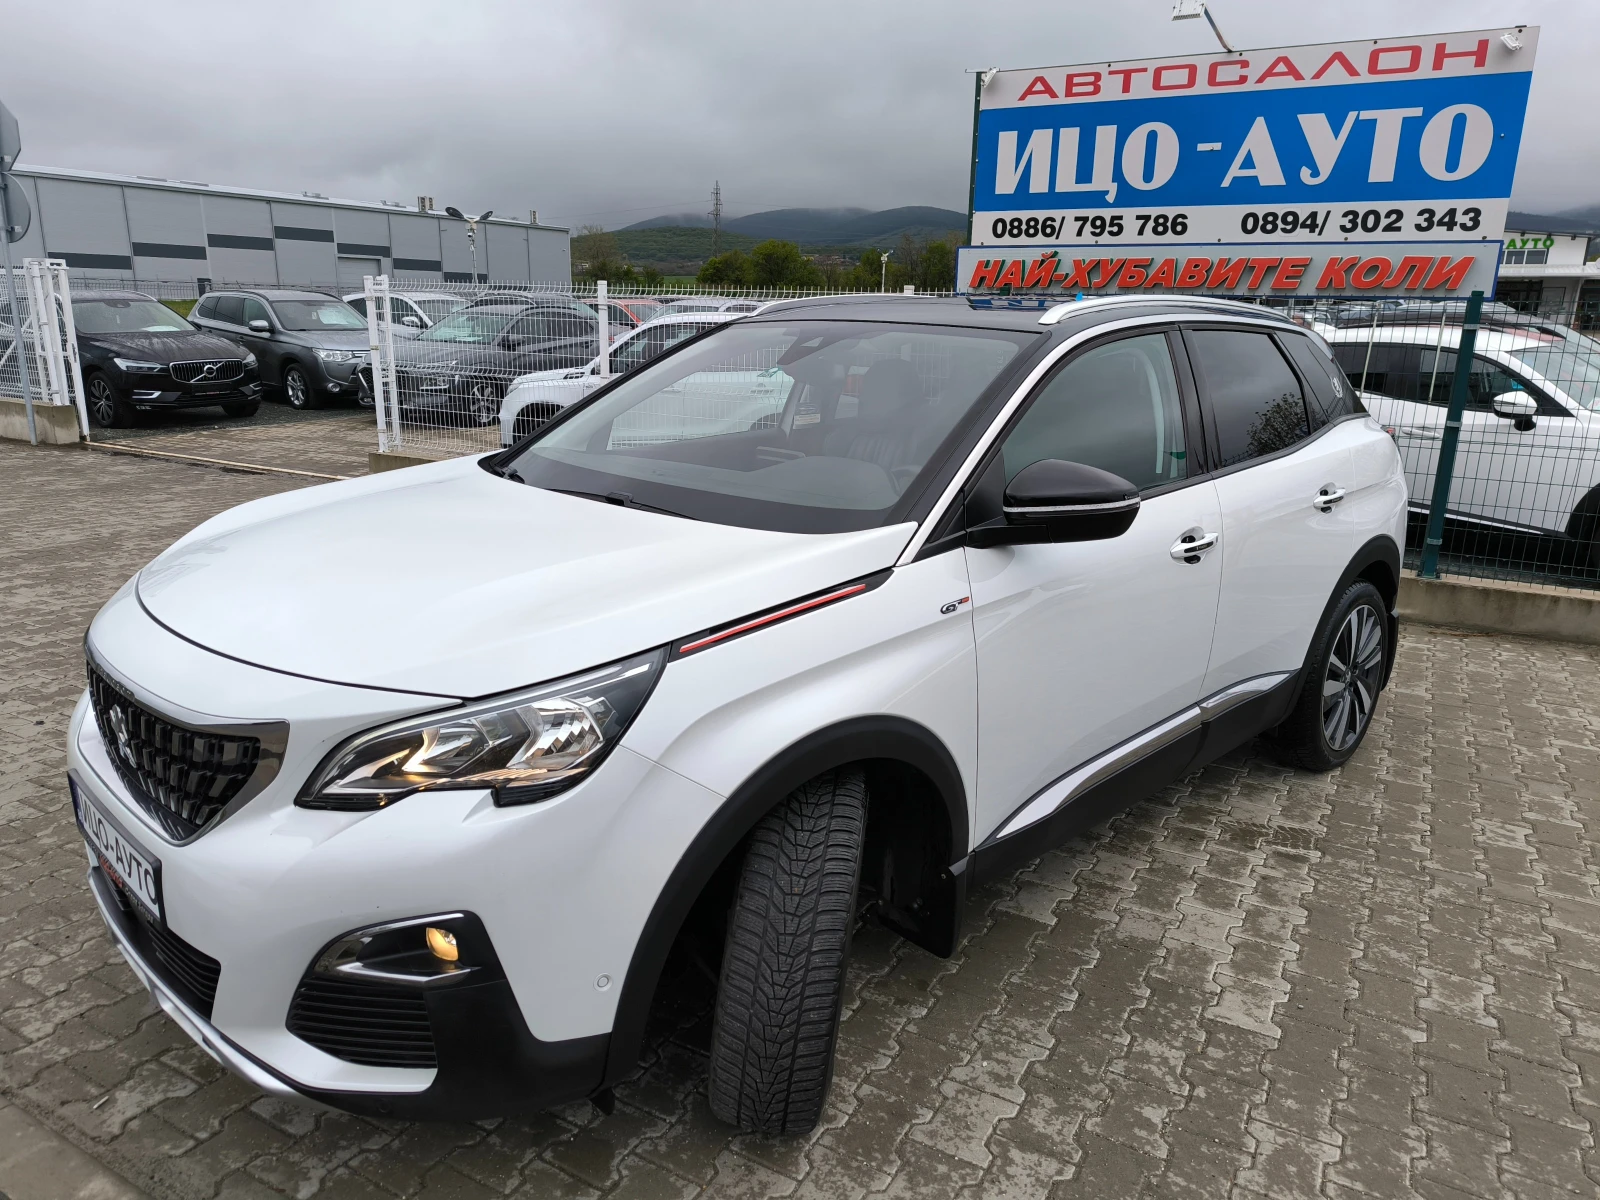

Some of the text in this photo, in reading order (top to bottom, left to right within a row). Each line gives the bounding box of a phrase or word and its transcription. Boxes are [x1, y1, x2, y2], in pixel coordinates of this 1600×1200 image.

[1017, 39, 1490, 102] АВТОСАЛОН
[991, 213, 1189, 240] 0886/ 795 786
[1240, 206, 1482, 236] 0894/ 302 343
[1505, 236, 1555, 250] АУТО
[968, 251, 1476, 290] НАЙ-ХУБАВИТЕ КОЛИ
[80, 792, 158, 906] ИЦО-АУТО
